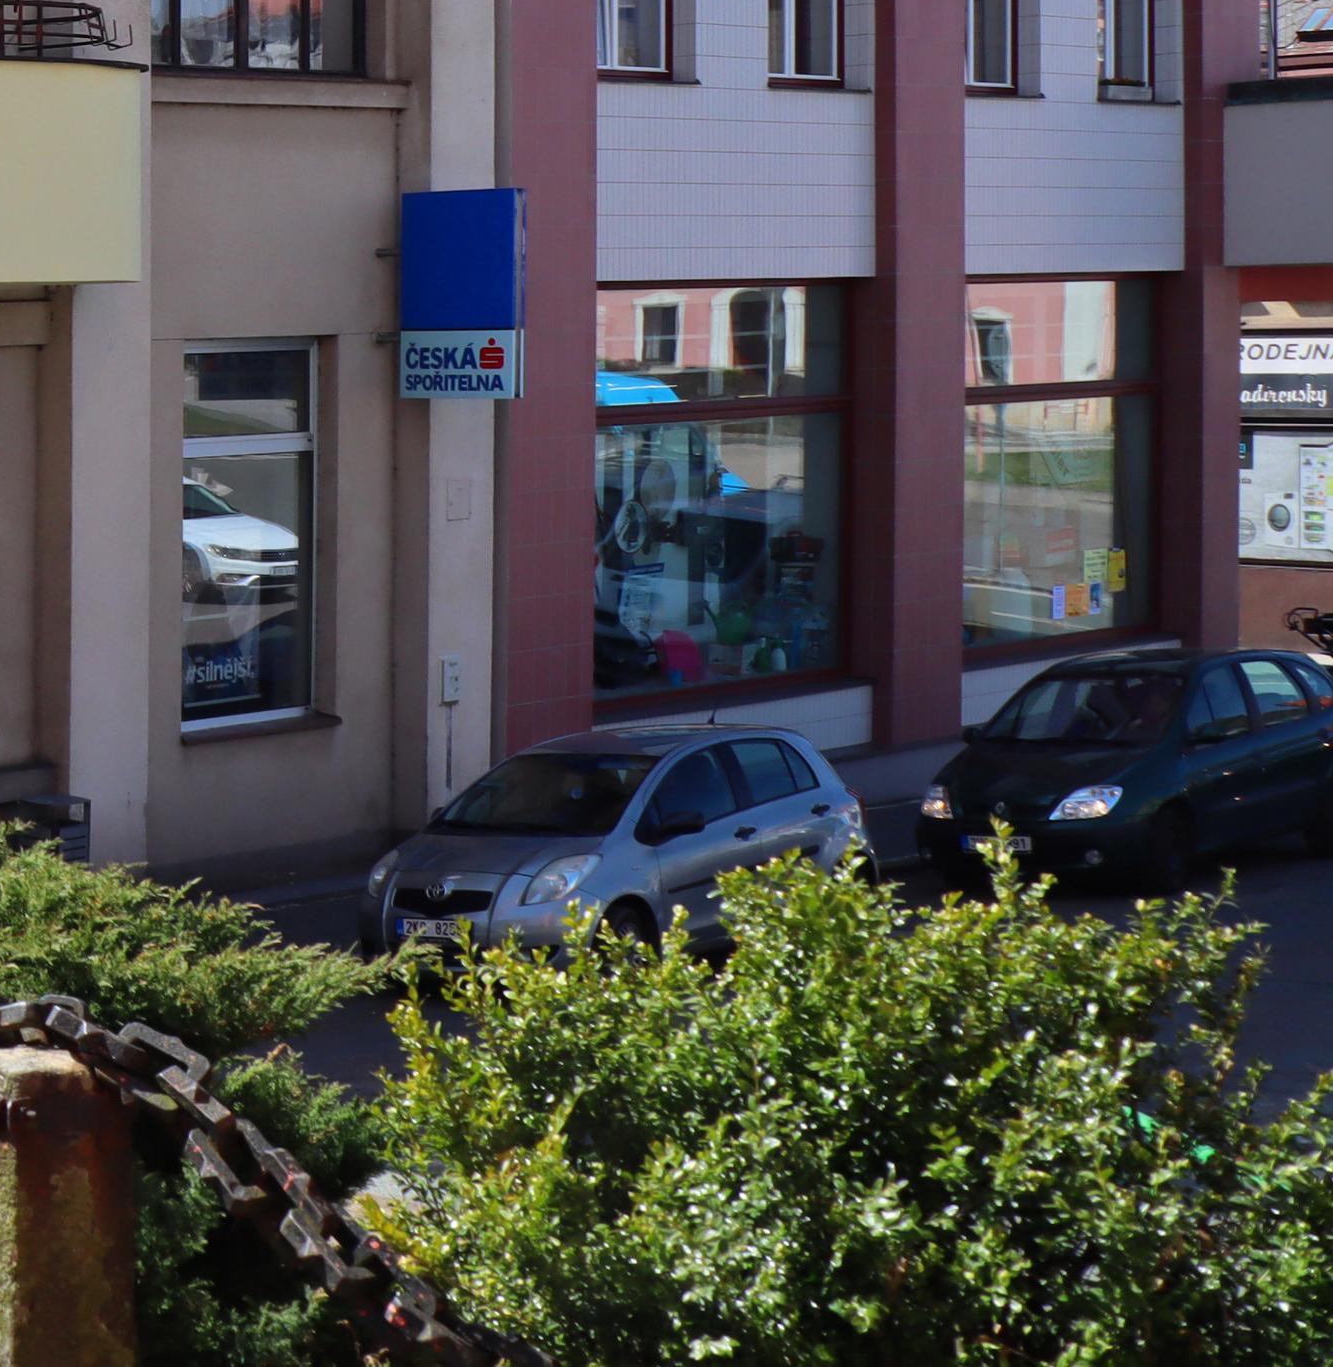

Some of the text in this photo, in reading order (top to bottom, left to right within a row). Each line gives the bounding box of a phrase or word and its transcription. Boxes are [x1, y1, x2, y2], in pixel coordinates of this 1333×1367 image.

[405, 342, 478, 370] ČESKÁ
[1237, 343, 1333, 361] ODEJN
[405, 371, 504, 392] SPOŘITELNA
